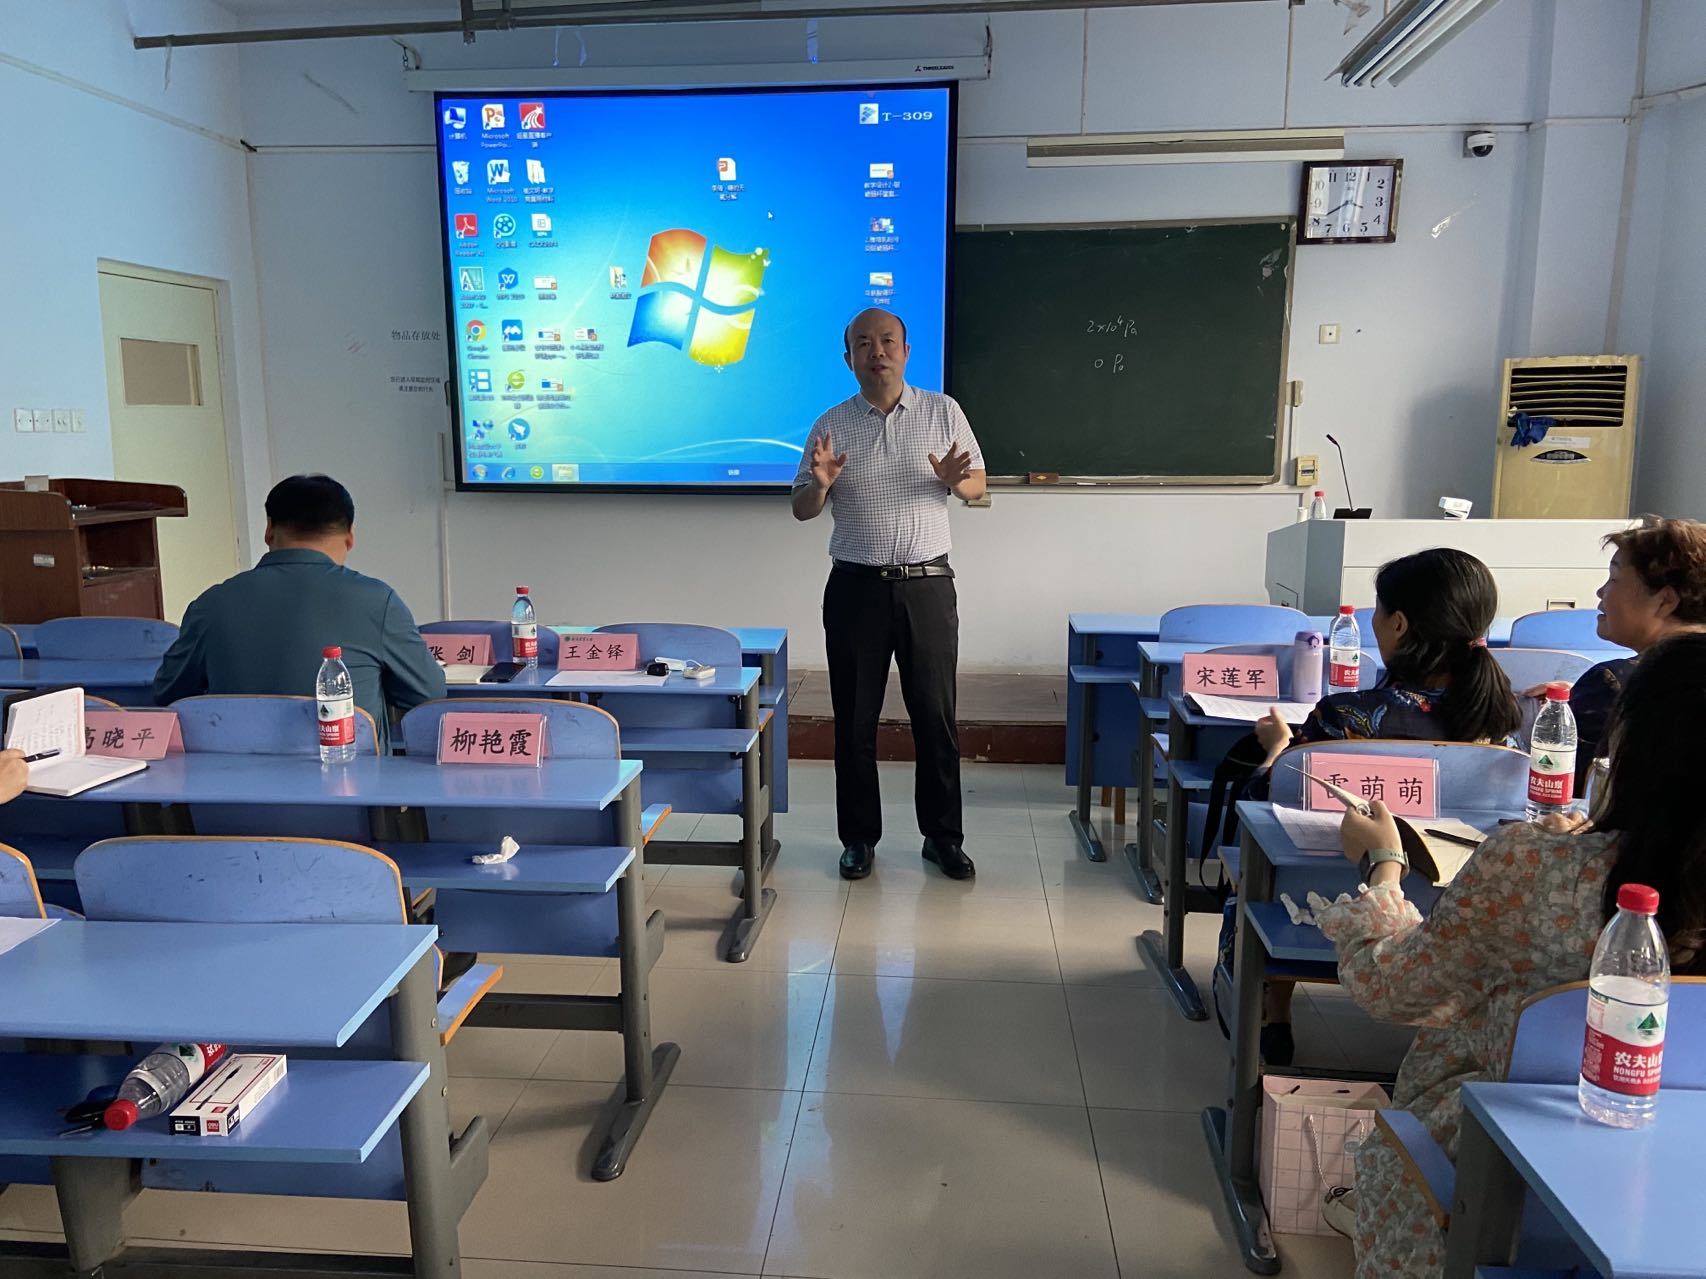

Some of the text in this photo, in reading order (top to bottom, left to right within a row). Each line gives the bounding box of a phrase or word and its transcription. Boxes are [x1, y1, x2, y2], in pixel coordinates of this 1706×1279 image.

[882, 111, 933, 121] T-309
[1329, 172, 1337, 182] 11
[1346, 172, 1356, 182] 12
[1315, 180, 1325, 191] 10
[1377, 179, 1385, 189] 2
[1314, 198, 1322, 208] 9
[1375, 196, 1384, 207] 3
[1373, 214, 1381, 225] 4
[1325, 224, 1333, 233] 7
[1342, 222, 1350, 233] 6
[1360, 222, 1368, 233] 5
[564, 644, 624, 661] 王金铎
[1196, 666, 1266, 690] 宋莲军
[450, 727, 532, 756] 柳艳霞
[1613, 1066, 1646, 1078] NONGFU
